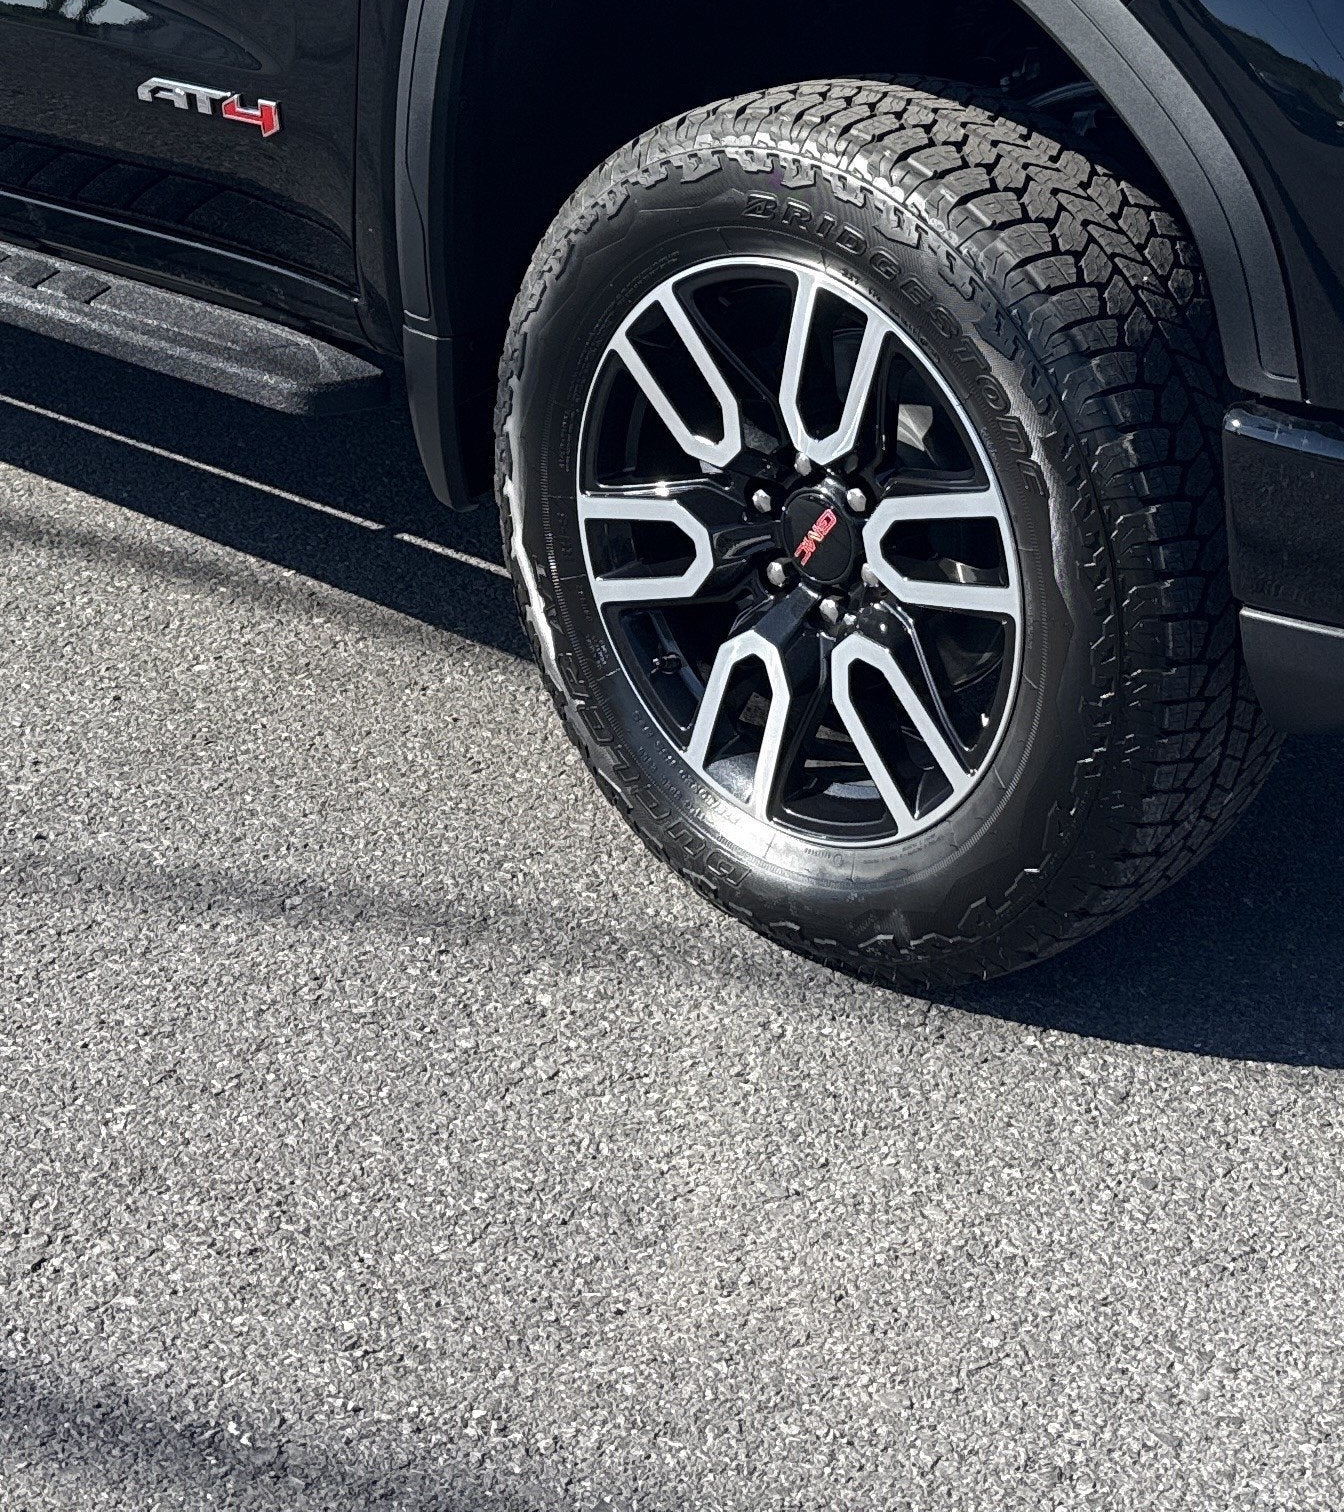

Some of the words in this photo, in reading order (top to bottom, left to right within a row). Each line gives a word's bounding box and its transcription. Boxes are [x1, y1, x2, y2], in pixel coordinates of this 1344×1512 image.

[137, 77, 281, 138] AT4
[740, 191, 1046, 497] BRIDGESTONE
[794, 508, 837, 566] GMC
